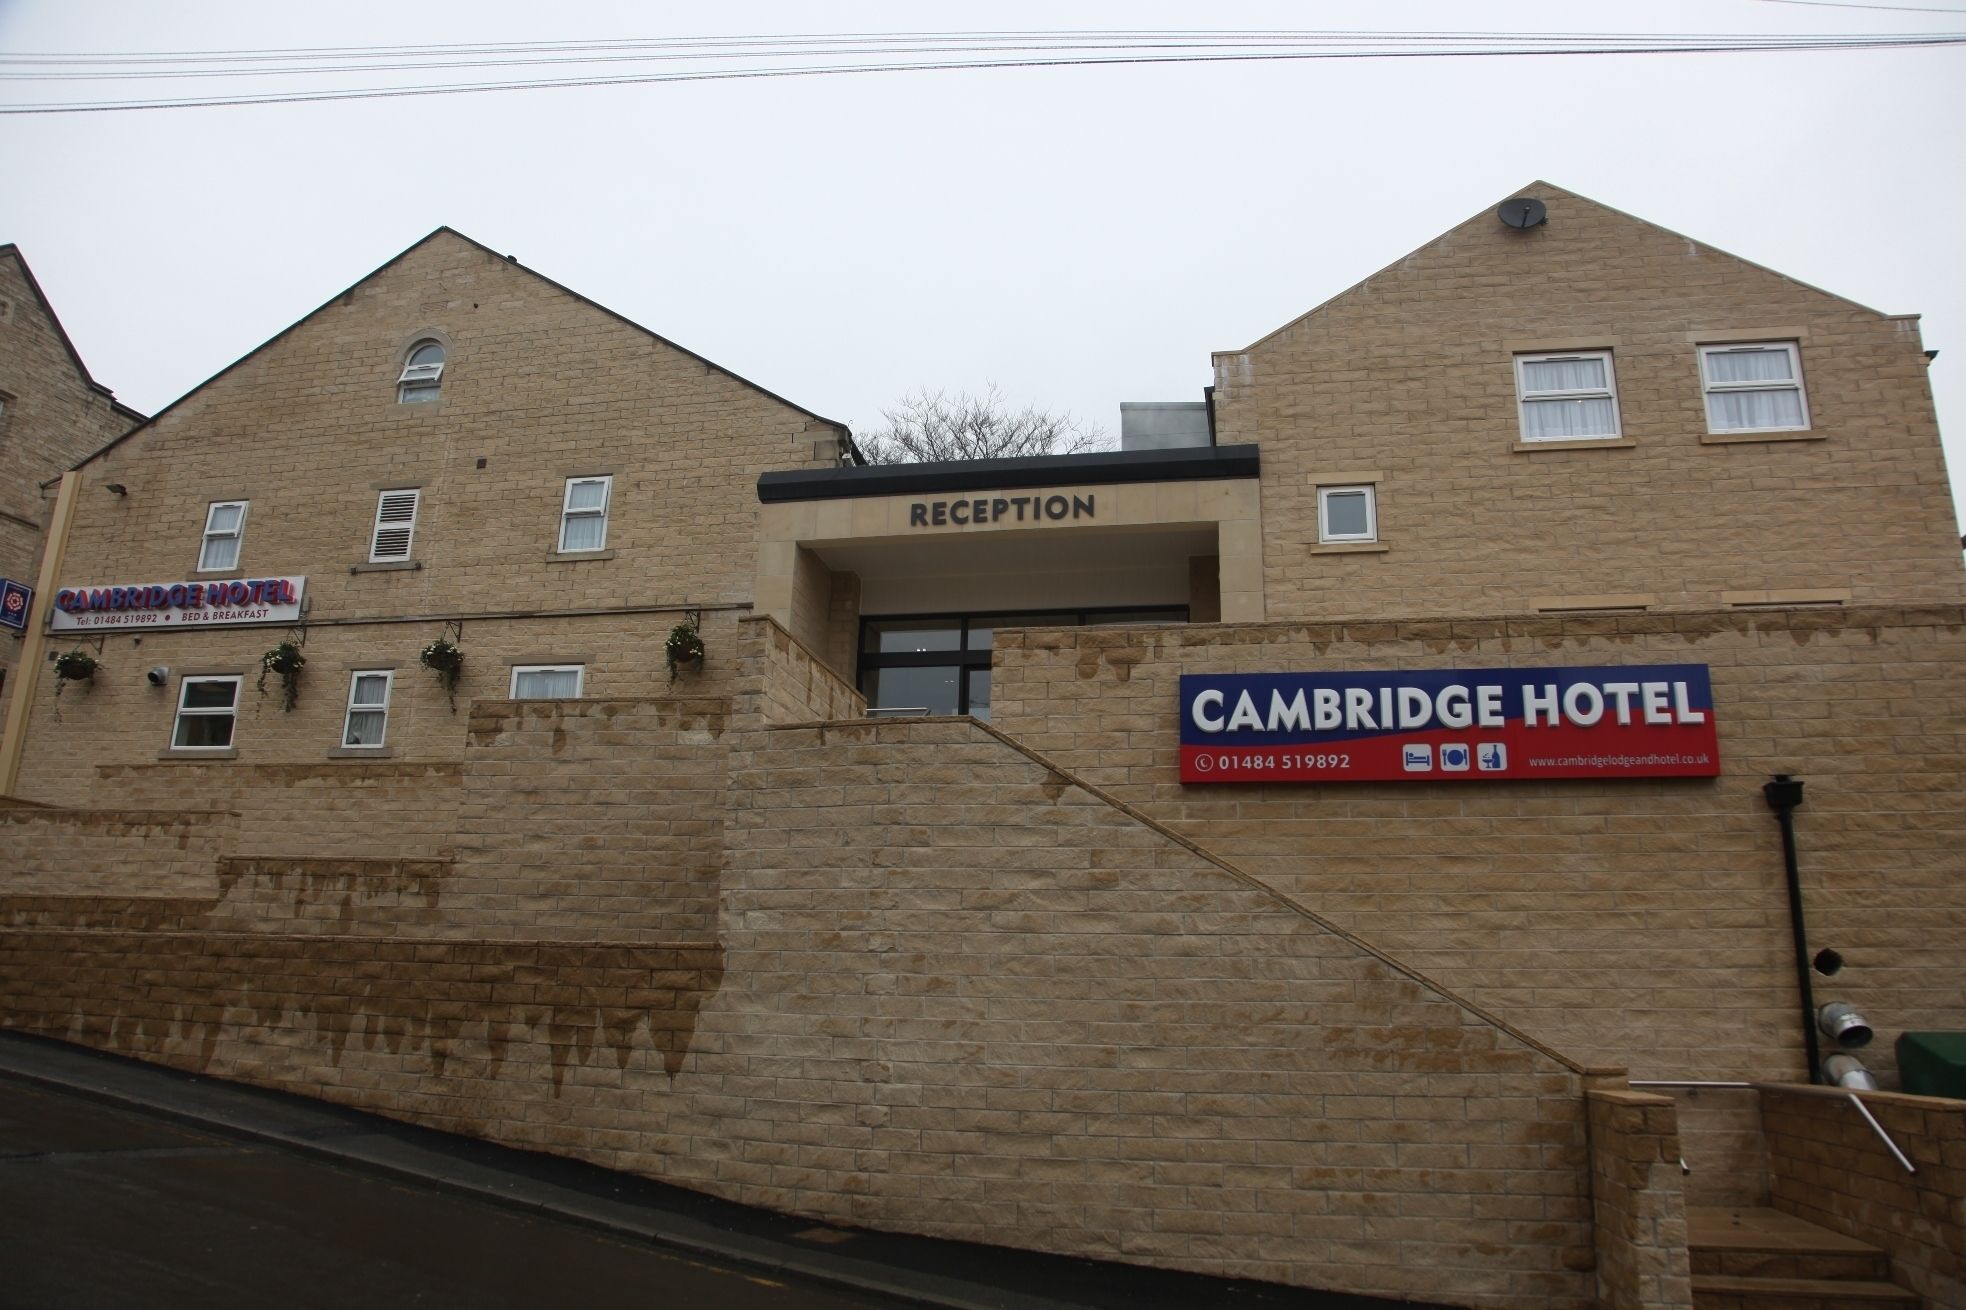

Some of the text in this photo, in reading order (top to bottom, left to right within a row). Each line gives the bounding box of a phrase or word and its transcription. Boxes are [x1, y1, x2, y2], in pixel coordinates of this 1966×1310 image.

[910, 494, 1095, 527] RECEPTION
[55, 579, 296, 612] CAMBRIDGE HOTEL
[76, 609, 269, 626] Tel: 01484 519892 BED & BREAKFAST
[1191, 681, 1705, 733] CAMBRIDGE HOTEL
[1218, 754, 1350, 770] 01484 519892
[1529, 753, 1710, 768] www.cambridgelodgeandhotel.co.uk
